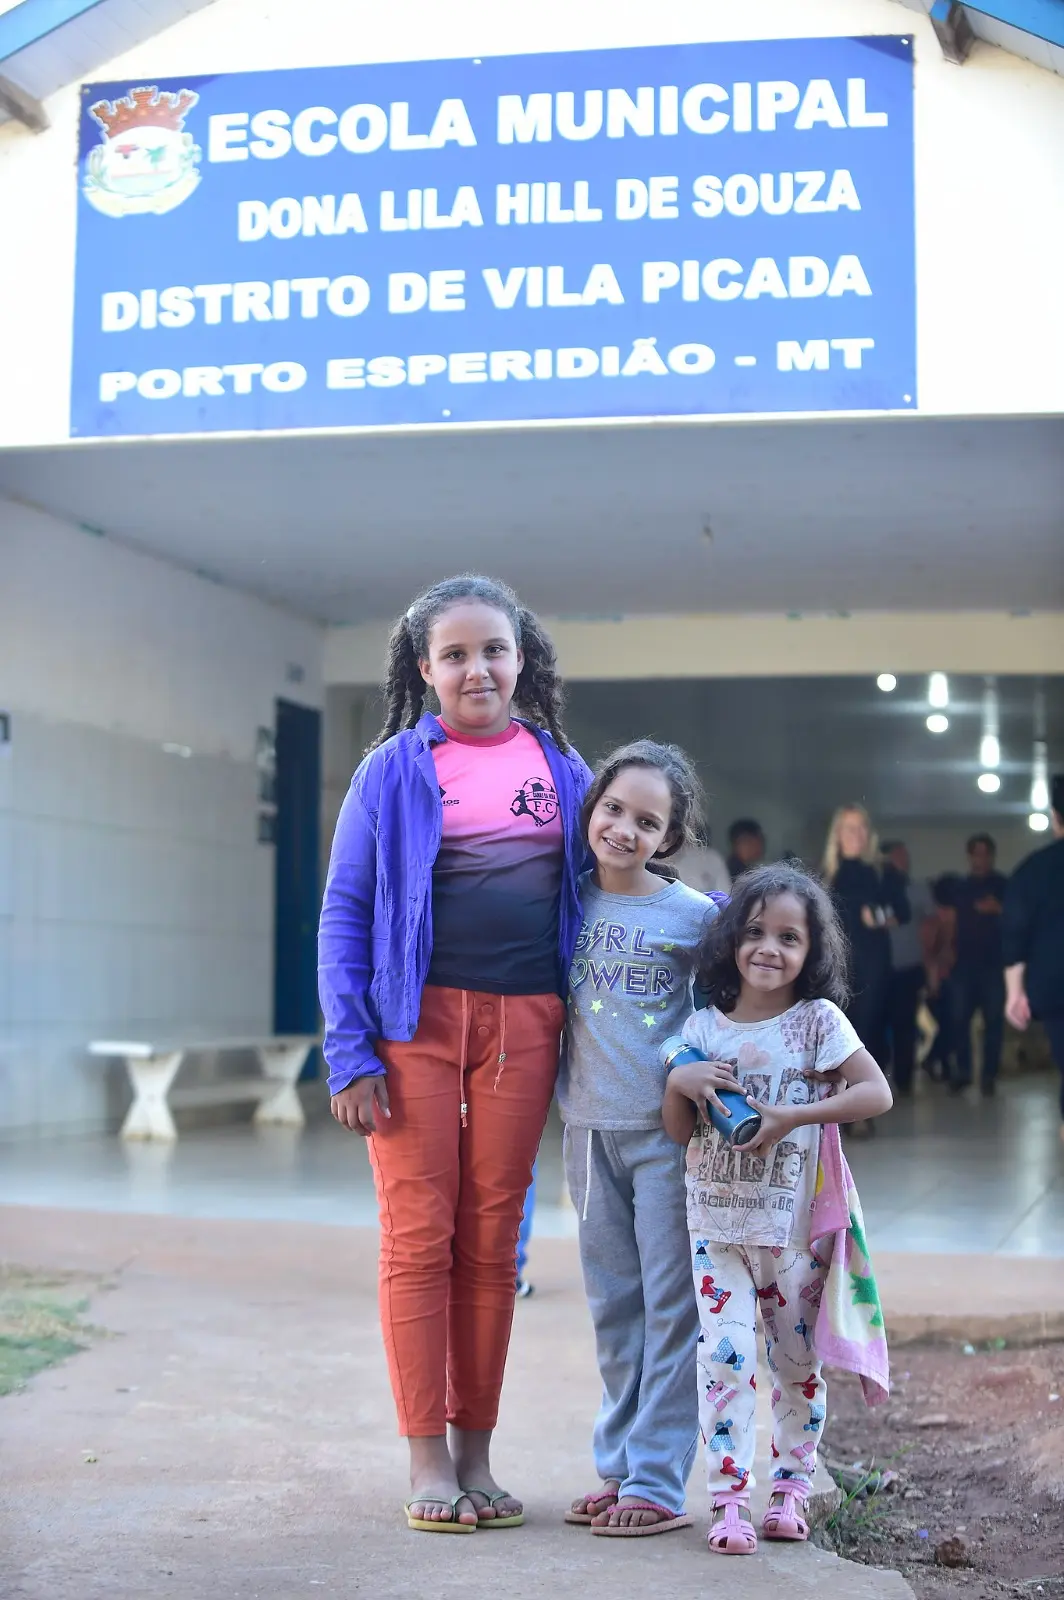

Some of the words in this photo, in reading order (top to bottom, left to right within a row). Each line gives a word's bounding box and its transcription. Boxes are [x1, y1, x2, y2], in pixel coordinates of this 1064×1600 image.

[208, 98, 477, 163] ESCOLA
[497, 78, 888, 144] MUNICIPAL
[237, 193, 368, 242] DONA
[380, 185, 484, 233] LILA
[496, 180, 603, 225] HILL
[616, 177, 680, 221] DE
[692, 169, 862, 219] SOUZA
[102, 274, 370, 332] DISTRITO
[388, 269, 466, 314] DE
[482, 264, 625, 309] VILA
[642, 254, 873, 304] PICADA
[100, 361, 307, 402] PORTO
[326, 337, 716, 391] ESPERIDIÃO
[735, 357, 757, 367] -
[777, 338, 876, 371] MT
[568, 957, 674, 996] OWER
